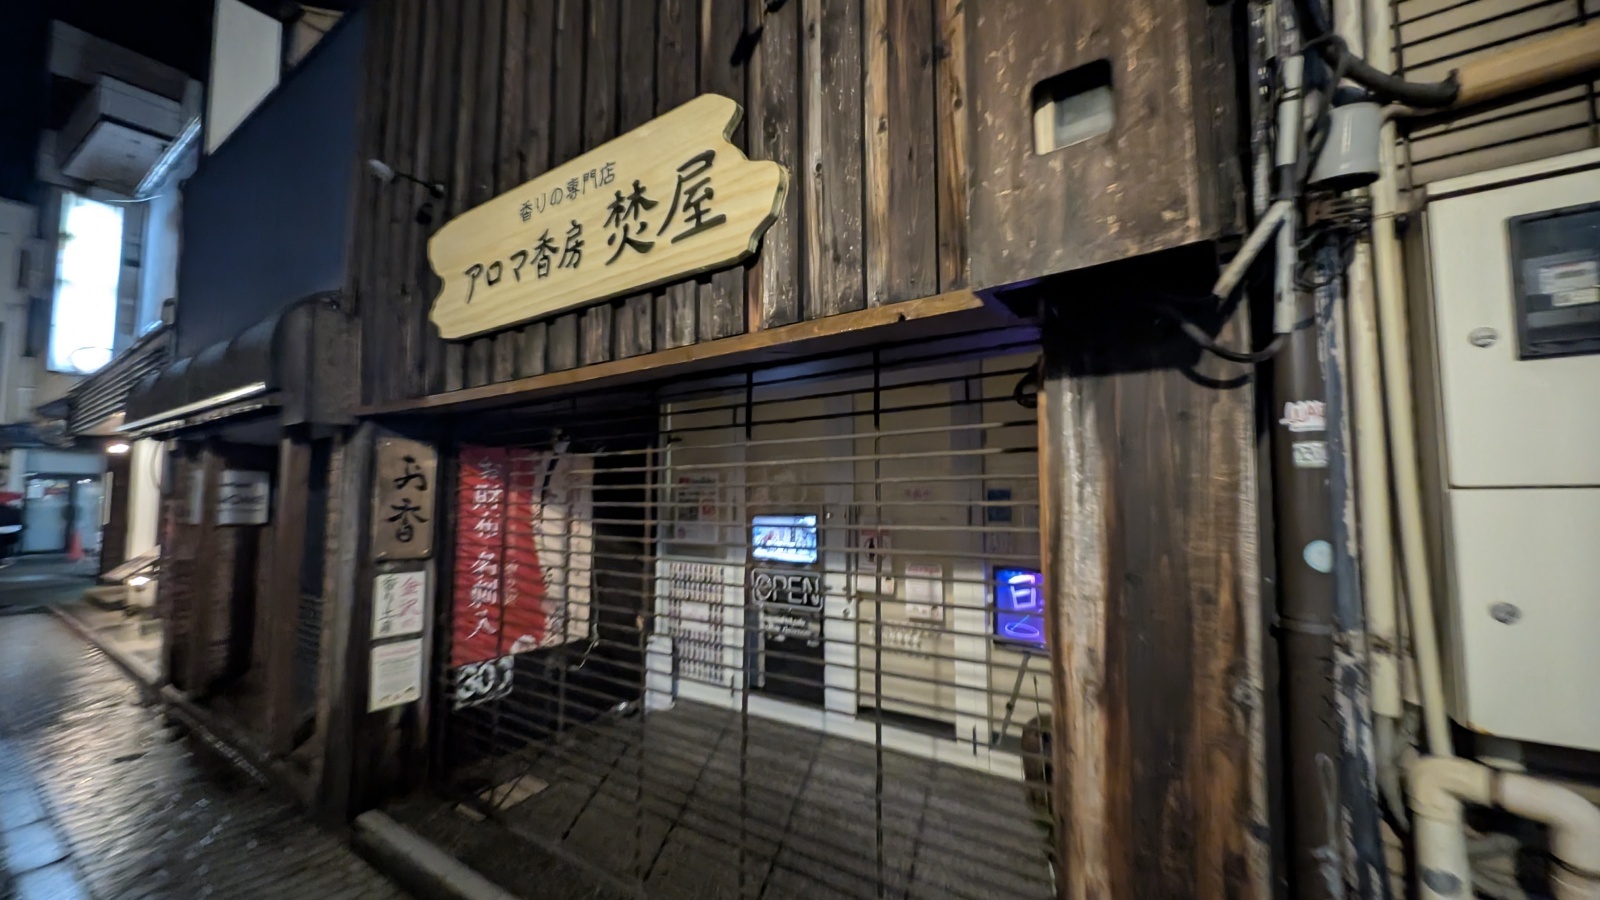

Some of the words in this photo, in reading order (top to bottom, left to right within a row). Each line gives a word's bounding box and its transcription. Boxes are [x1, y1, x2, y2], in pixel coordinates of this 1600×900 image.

[464, 220, 584, 304] アロマ香房
[603, 149, 727, 265] 焚屋
[520, 161, 616, 222] 香りの専門店
[387, 455, 429, 542] お香
[755, 573, 820, 606] OPEN
